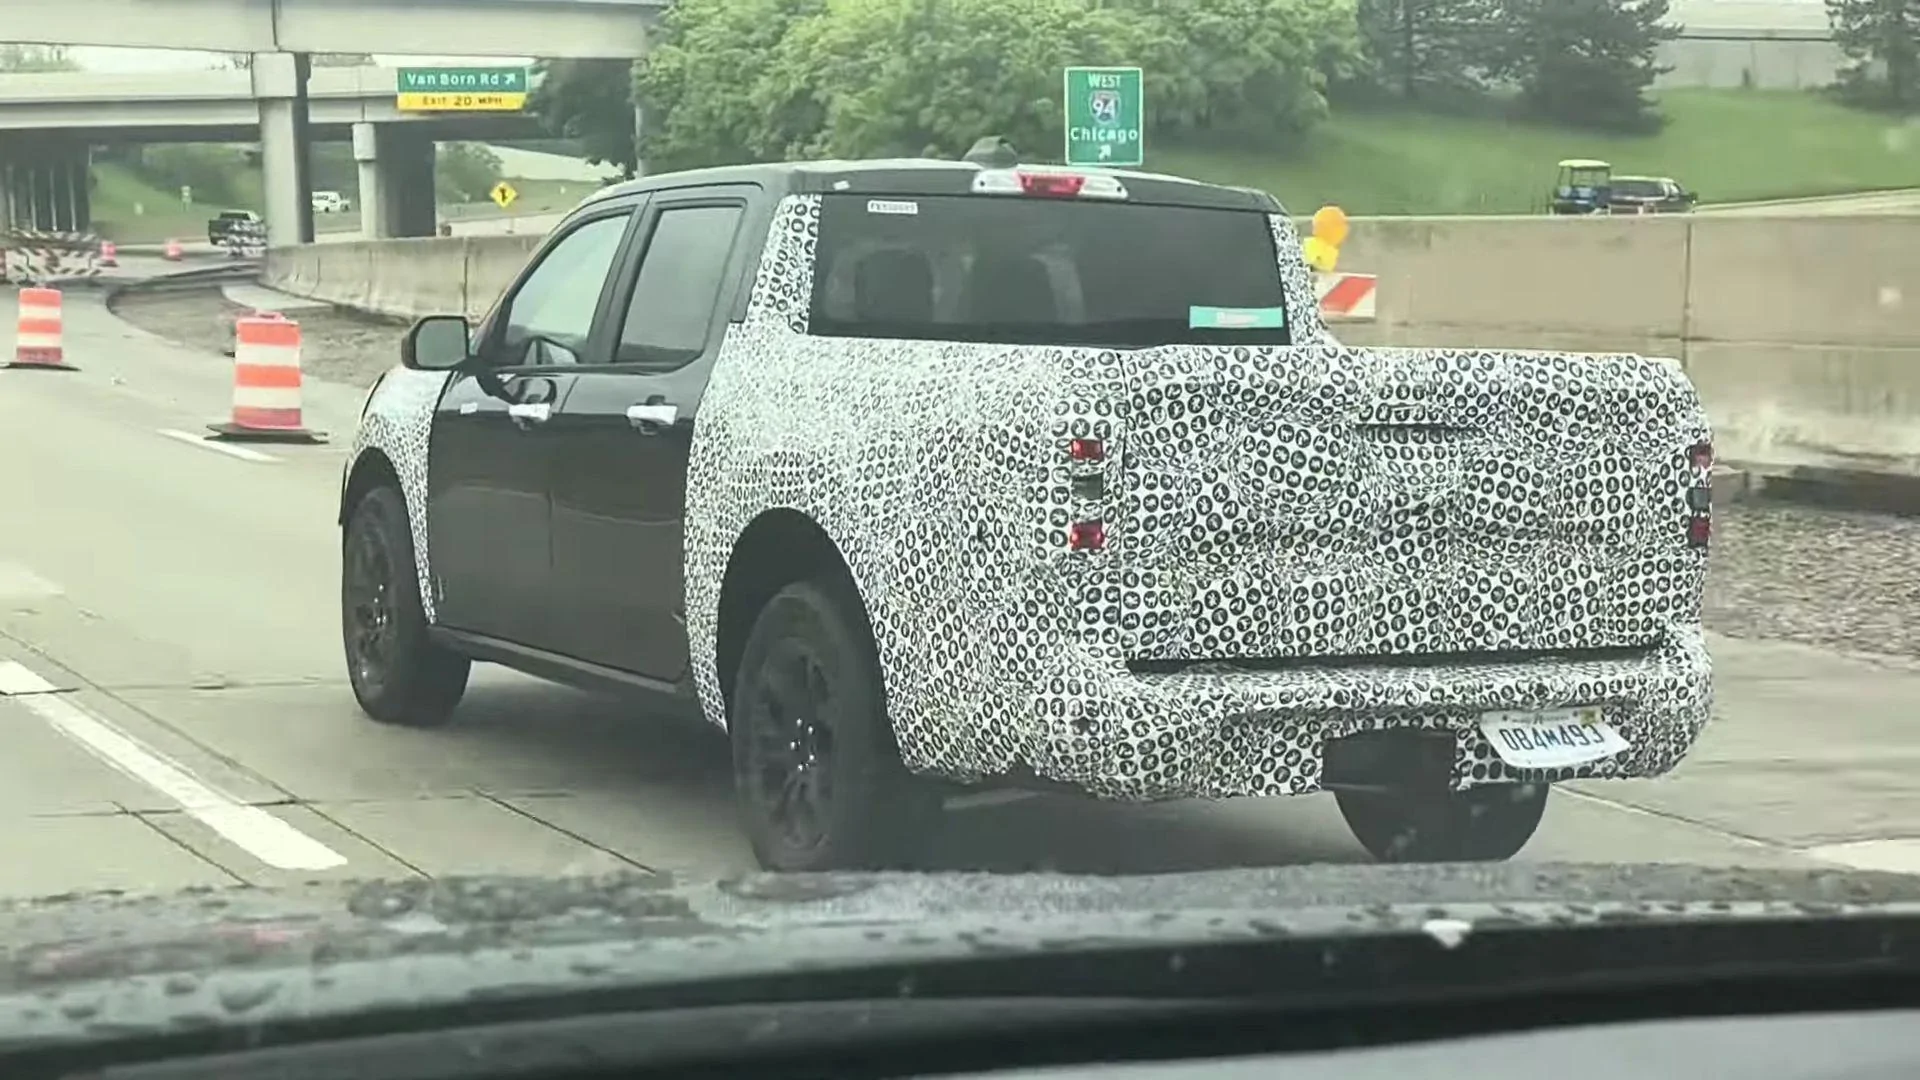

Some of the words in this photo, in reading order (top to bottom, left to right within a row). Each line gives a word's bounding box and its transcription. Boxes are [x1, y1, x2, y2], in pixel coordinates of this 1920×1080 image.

[406, 73, 436, 85] Van
[439, 73, 476, 85] Born
[480, 73, 499, 85] Rd
[1087, 72, 1121, 88] WEST
[453, 96, 473, 107] 20
[478, 97, 503, 105] MPH
[1092, 99, 1116, 120] 94
[1070, 126, 1138, 144] Chicago
